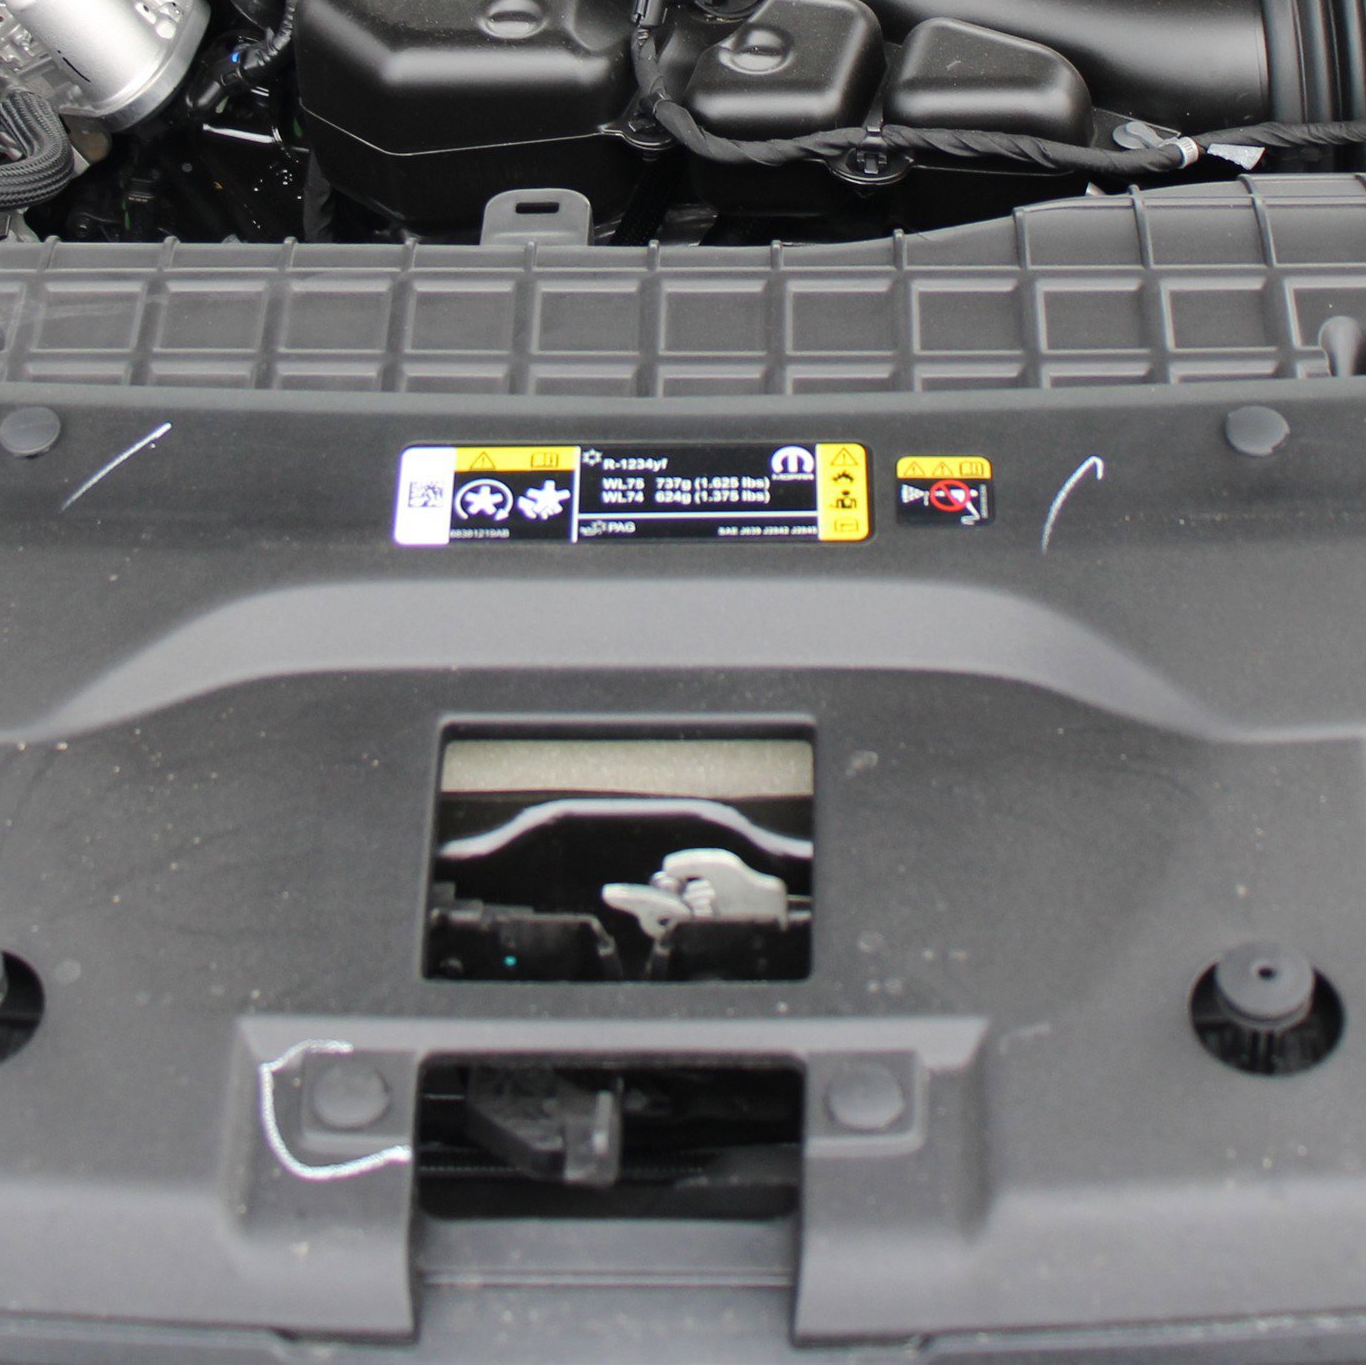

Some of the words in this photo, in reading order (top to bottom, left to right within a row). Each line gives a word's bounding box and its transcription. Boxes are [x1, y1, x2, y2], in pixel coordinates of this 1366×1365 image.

[603, 457, 668, 472] R-1234yf
[602, 477, 645, 490] WL75
[655, 477, 692, 492] 737g
[741, 476, 771, 491] lbs)
[602, 490, 645, 503] WL74
[655, 490, 692, 505] 624g
[694, 490, 739, 504] (1.375
[741, 489, 771, 504] lbs)
[608, 521, 636, 533] PAG
